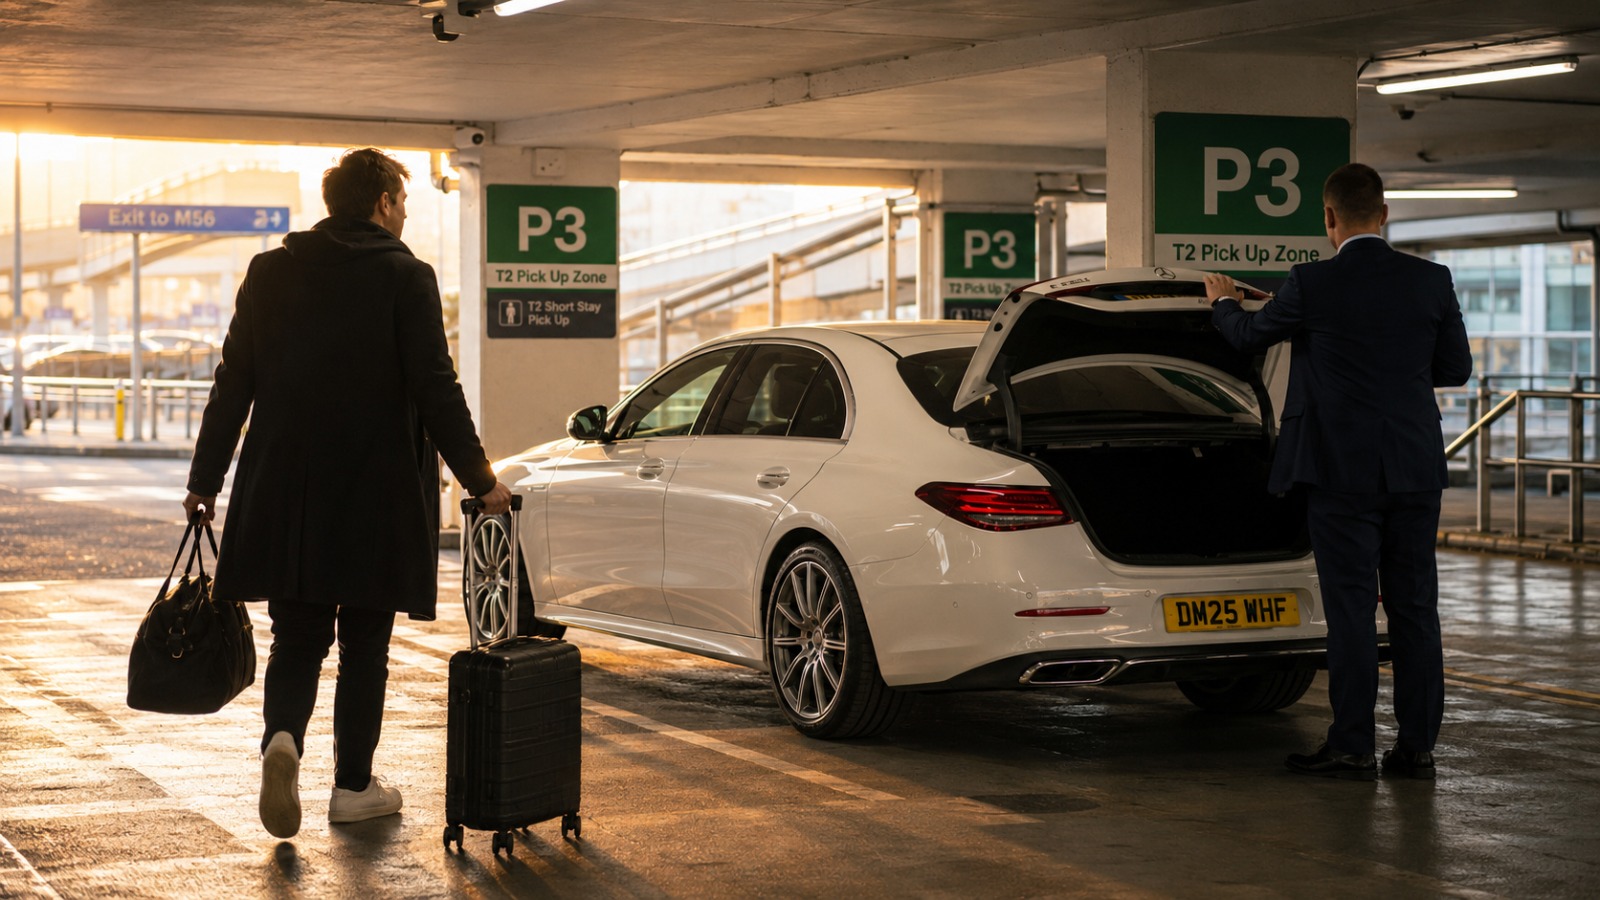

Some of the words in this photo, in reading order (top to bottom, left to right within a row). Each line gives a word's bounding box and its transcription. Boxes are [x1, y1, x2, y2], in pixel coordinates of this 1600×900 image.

[1203, 146, 1301, 217] P3
[108, 208, 145, 226] Exit
[150, 209, 169, 226] to
[174, 209, 216, 227] M56
[518, 206, 587, 253] P3
[964, 229, 1017, 269] P3
[1172, 243, 1196, 261] T2
[1201, 244, 1240, 262] Pick
[1245, 244, 1270, 266] Up
[1274, 245, 1320, 263] Zone
[495, 269, 513, 282] T2
[517, 270, 547, 283] Pick
[550, 270, 569, 285] Up
[573, 270, 607, 283] Zone
[949, 283, 962, 293] T2
[964, 282, 985, 293] Pick
[988, 283, 1002, 295] Up
[528, 301, 542, 312] T2
[544, 301, 575, 312] Short
[577, 302, 602, 314] Stay
[528, 315, 552, 326] Pick
[554, 315, 570, 327] Up
[1175, 600, 1239, 627] DM25
[1243, 598, 1287, 623] WHF
